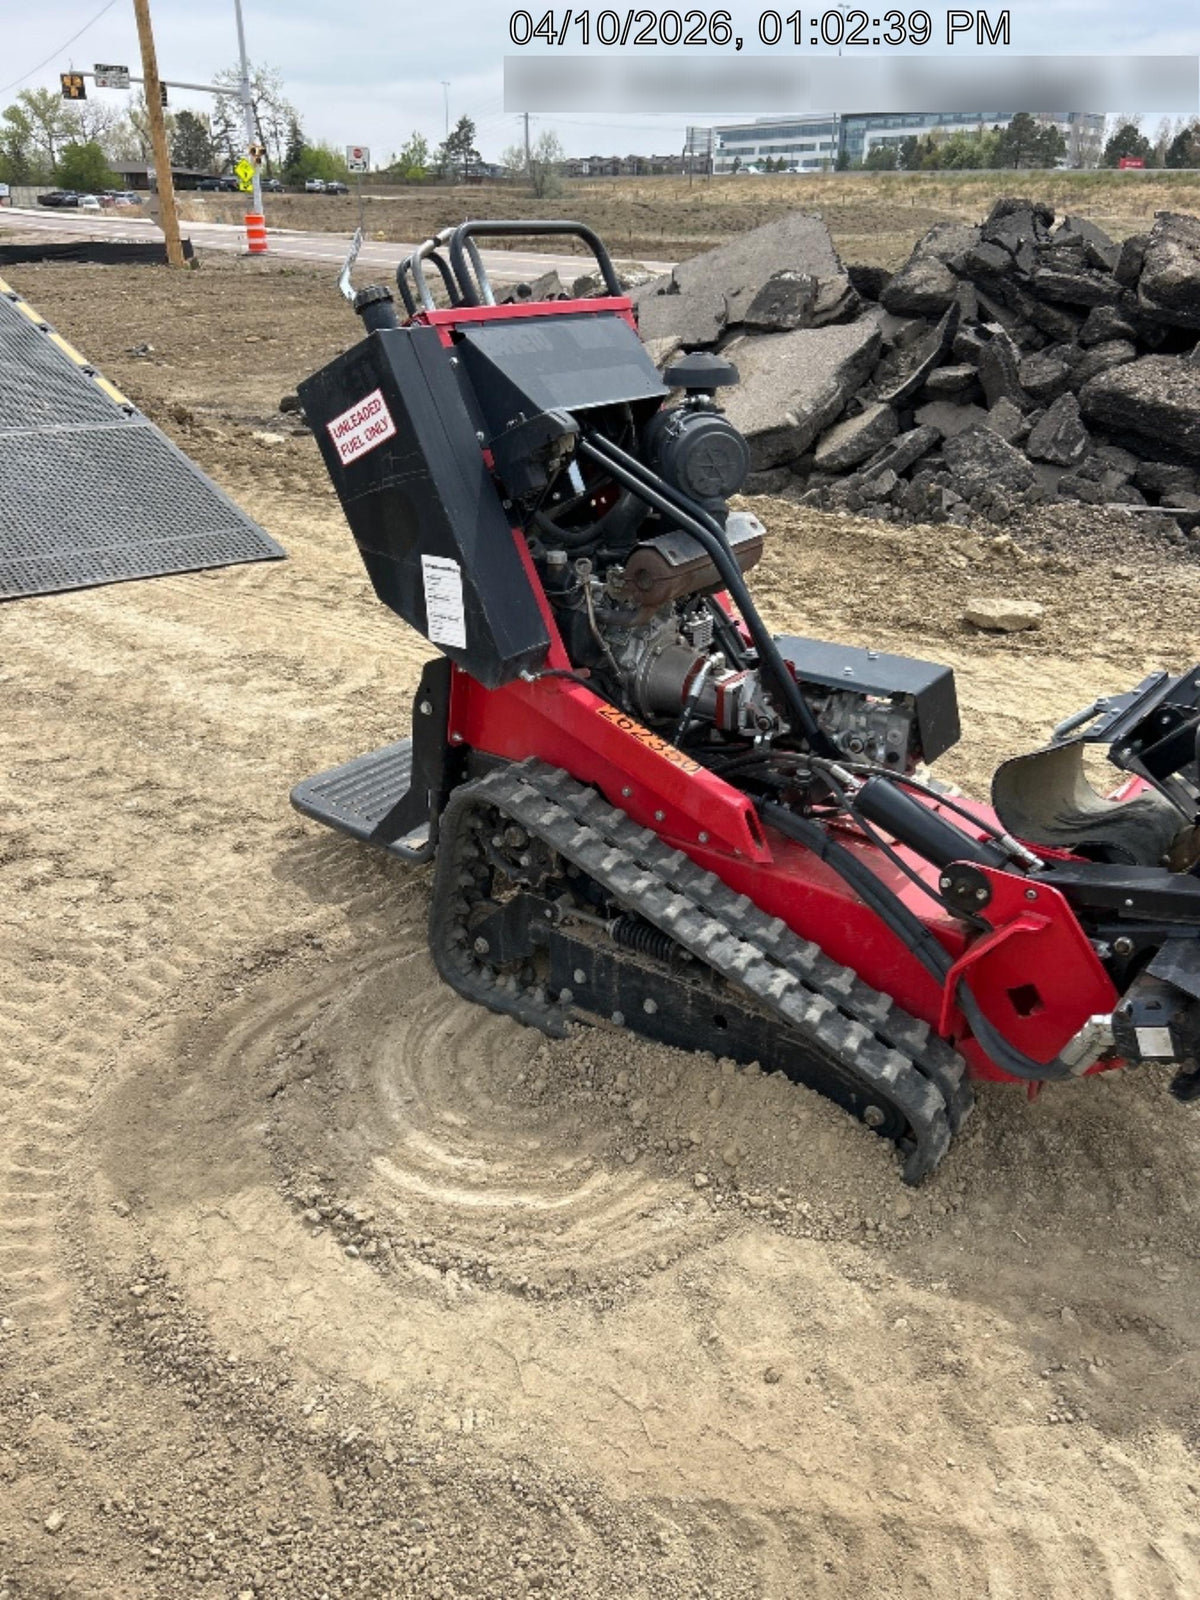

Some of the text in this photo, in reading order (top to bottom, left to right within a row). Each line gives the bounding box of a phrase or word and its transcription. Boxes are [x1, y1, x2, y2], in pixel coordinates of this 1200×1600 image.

[332, 398, 382, 439] UNLEADED
[340, 415, 388, 457] FUEL ONLY
